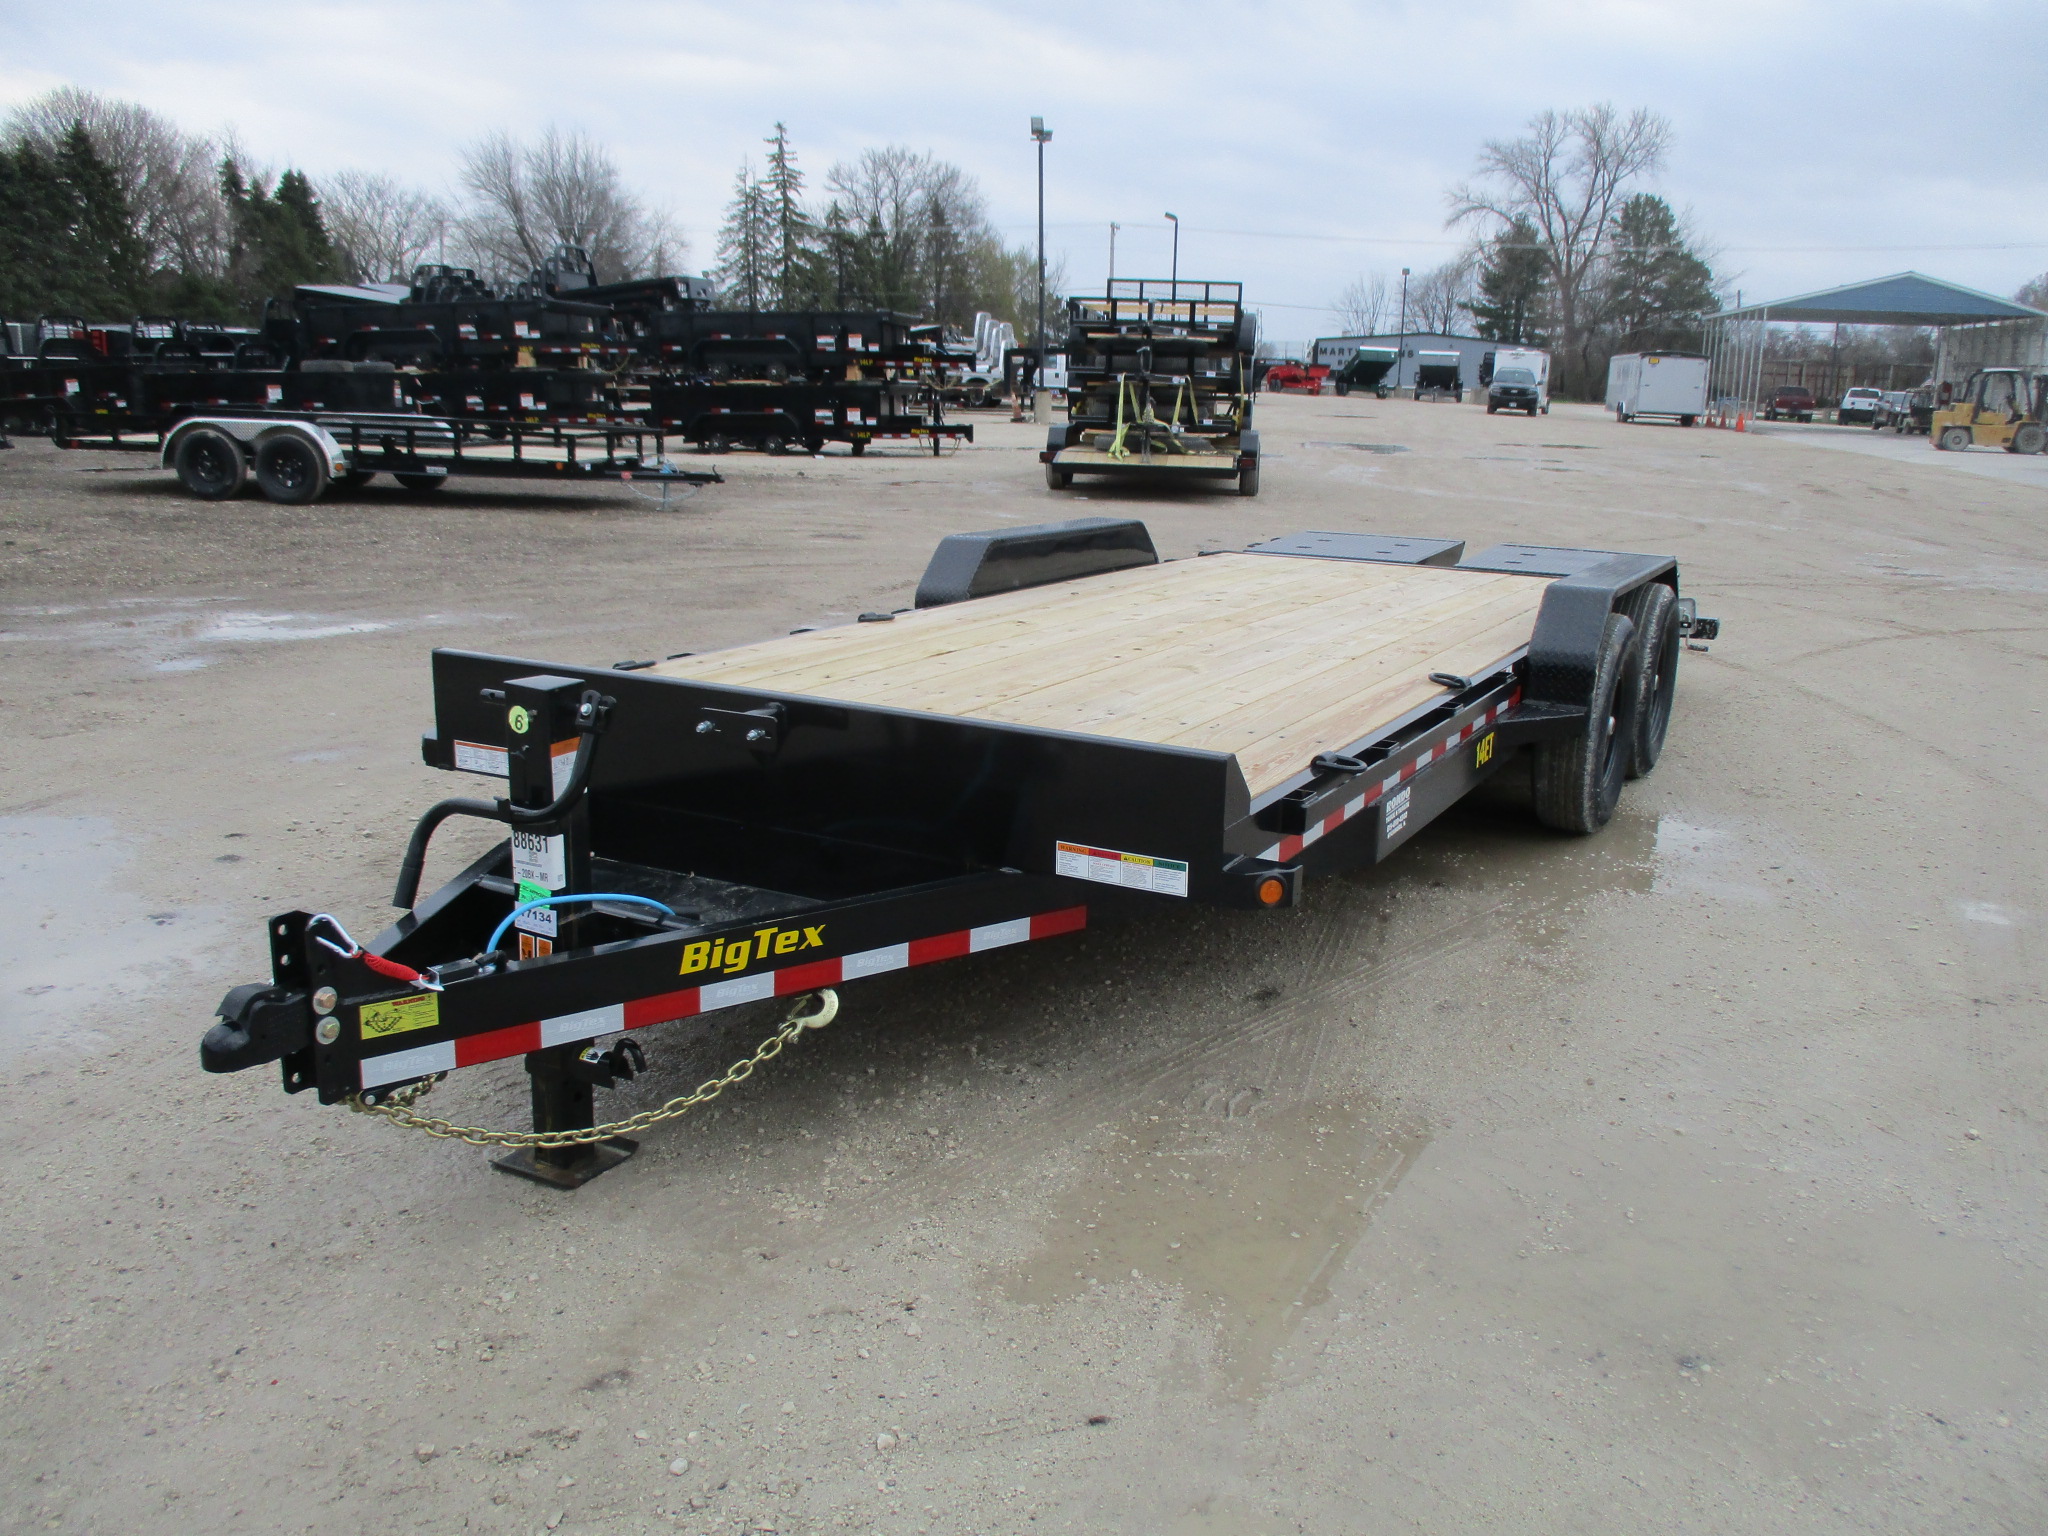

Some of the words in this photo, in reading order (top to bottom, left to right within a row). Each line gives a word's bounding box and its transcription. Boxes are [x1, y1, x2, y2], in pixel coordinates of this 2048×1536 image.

[515, 714, 524, 731] 6
[513, 831, 548, 854] 88631
[1060, 845, 1087, 855] WARNING
[1127, 856, 1151, 865] CAUTION
[679, 924, 827, 976] BigTex
